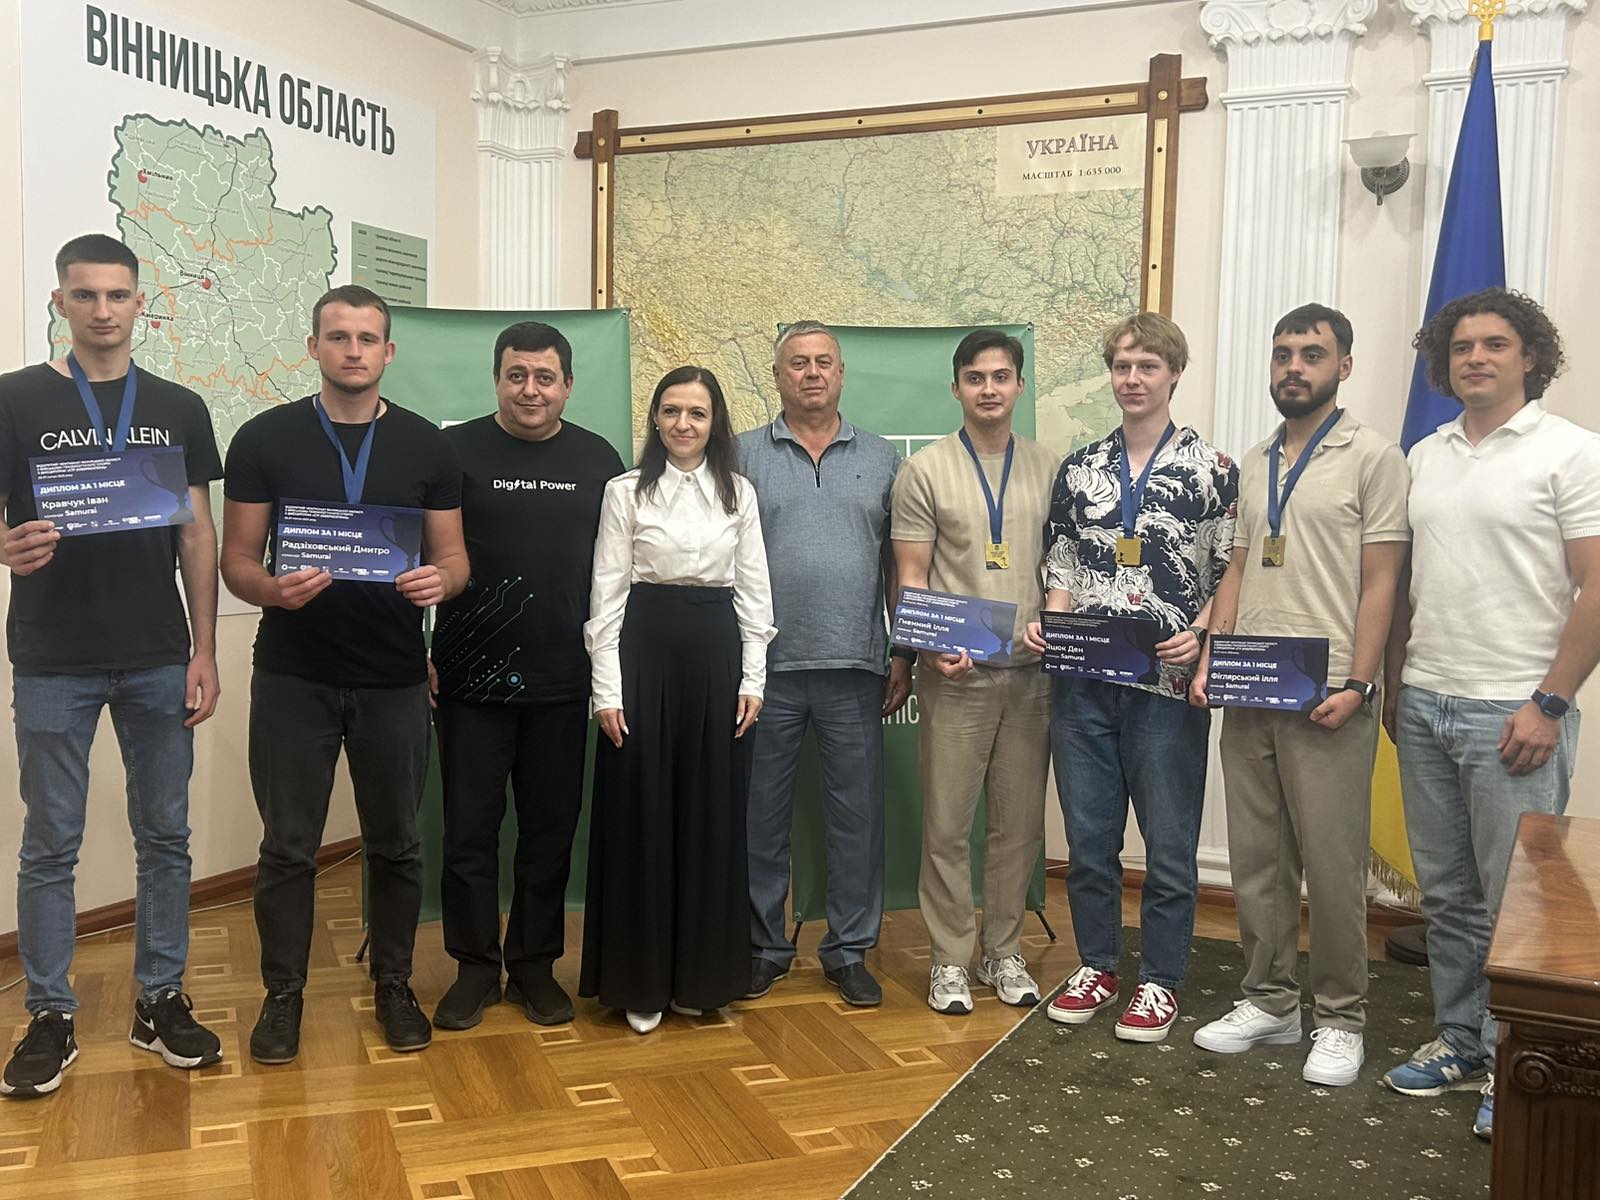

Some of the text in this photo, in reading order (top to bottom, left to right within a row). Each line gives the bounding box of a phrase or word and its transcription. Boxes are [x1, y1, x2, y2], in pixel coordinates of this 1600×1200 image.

[86, 4, 395, 155] ВІННИЦЬКА ОБЛАСТЬ
[1026, 133, 1119, 158] УКРАЇНА
[1022, 169, 1073, 181] МАСШТАБ
[126, 427, 170, 446] LEIN
[40, 484, 79, 495] ДИПЛОМ
[80, 482, 92, 490] ЗА
[99, 480, 126, 488] МІСЦЕ
[540, 480, 577, 491] Power
[42, 497, 108, 510] Кравчук Іван
[65, 507, 98, 517] Samurai
[283, 527, 319, 535] ДИПЛОМ
[338, 531, 363, 539] МІСЦЕ
[282, 541, 390, 555] Радзіховський Дмитро
[301, 552, 331, 560] Samurai
[900, 608, 930, 618] ДИПЛОМ
[944, 615, 966, 624] МІСЦЕ
[1045, 632, 1075, 640] ДИПЛОМ
[1089, 636, 1110, 644] МІСЦЕ
[1067, 645, 1084, 653] Ден
[1225, 682, 1250, 690] Samurai
